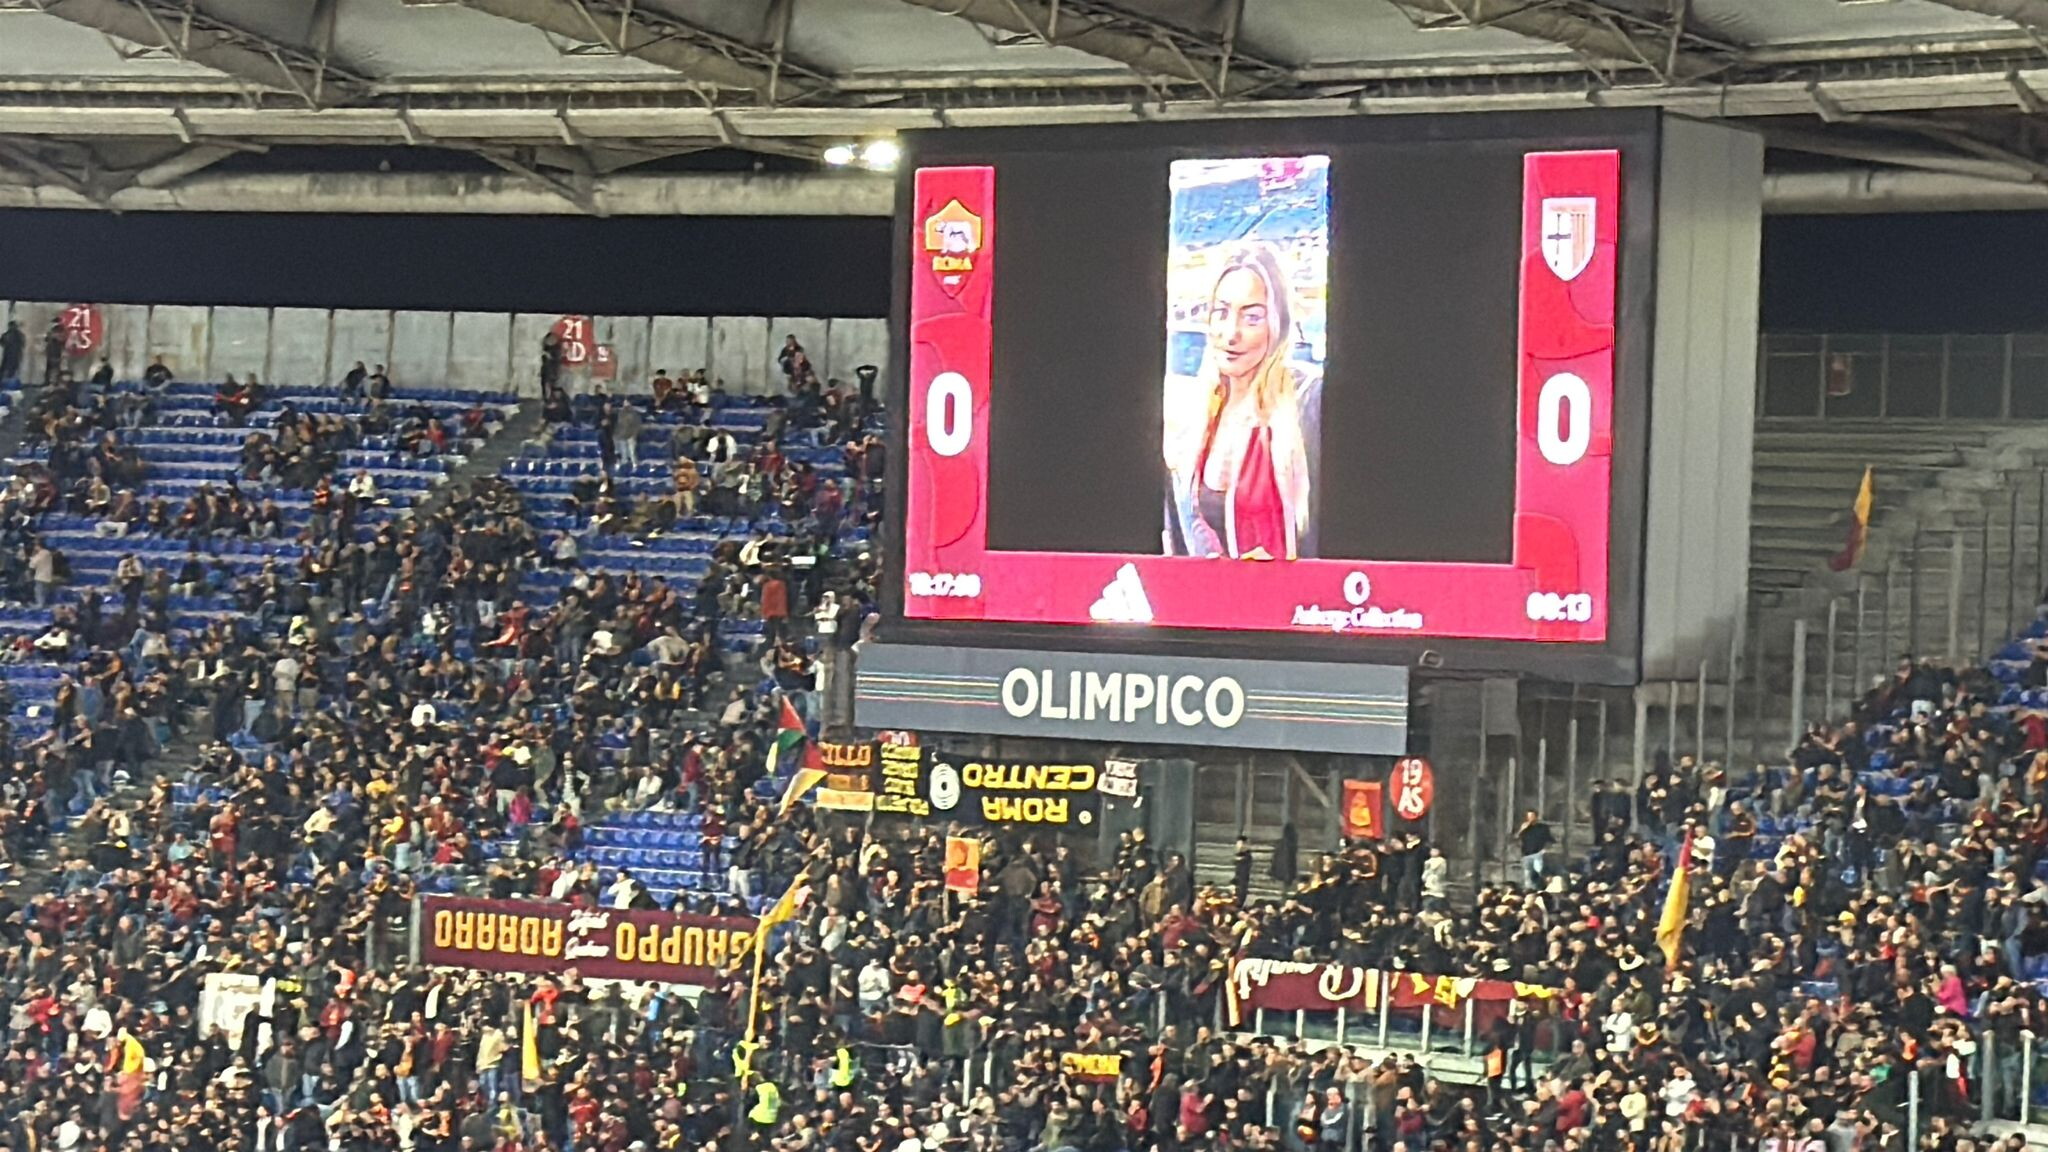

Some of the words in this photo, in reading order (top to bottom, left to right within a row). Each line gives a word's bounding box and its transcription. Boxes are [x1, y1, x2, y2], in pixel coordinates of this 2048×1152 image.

[69, 308, 90, 327] 21
[563, 319, 583, 339] 21
[927, 371, 973, 457] 0
[1538, 372, 1592, 466] 0
[1002, 667, 1244, 728] OLIMPICO
[962, 763, 1096, 791] CENTRO
[1401, 759, 1423, 785] 19
[982, 796, 1069, 823] ROMA
[1397, 785, 1424, 814] AS
